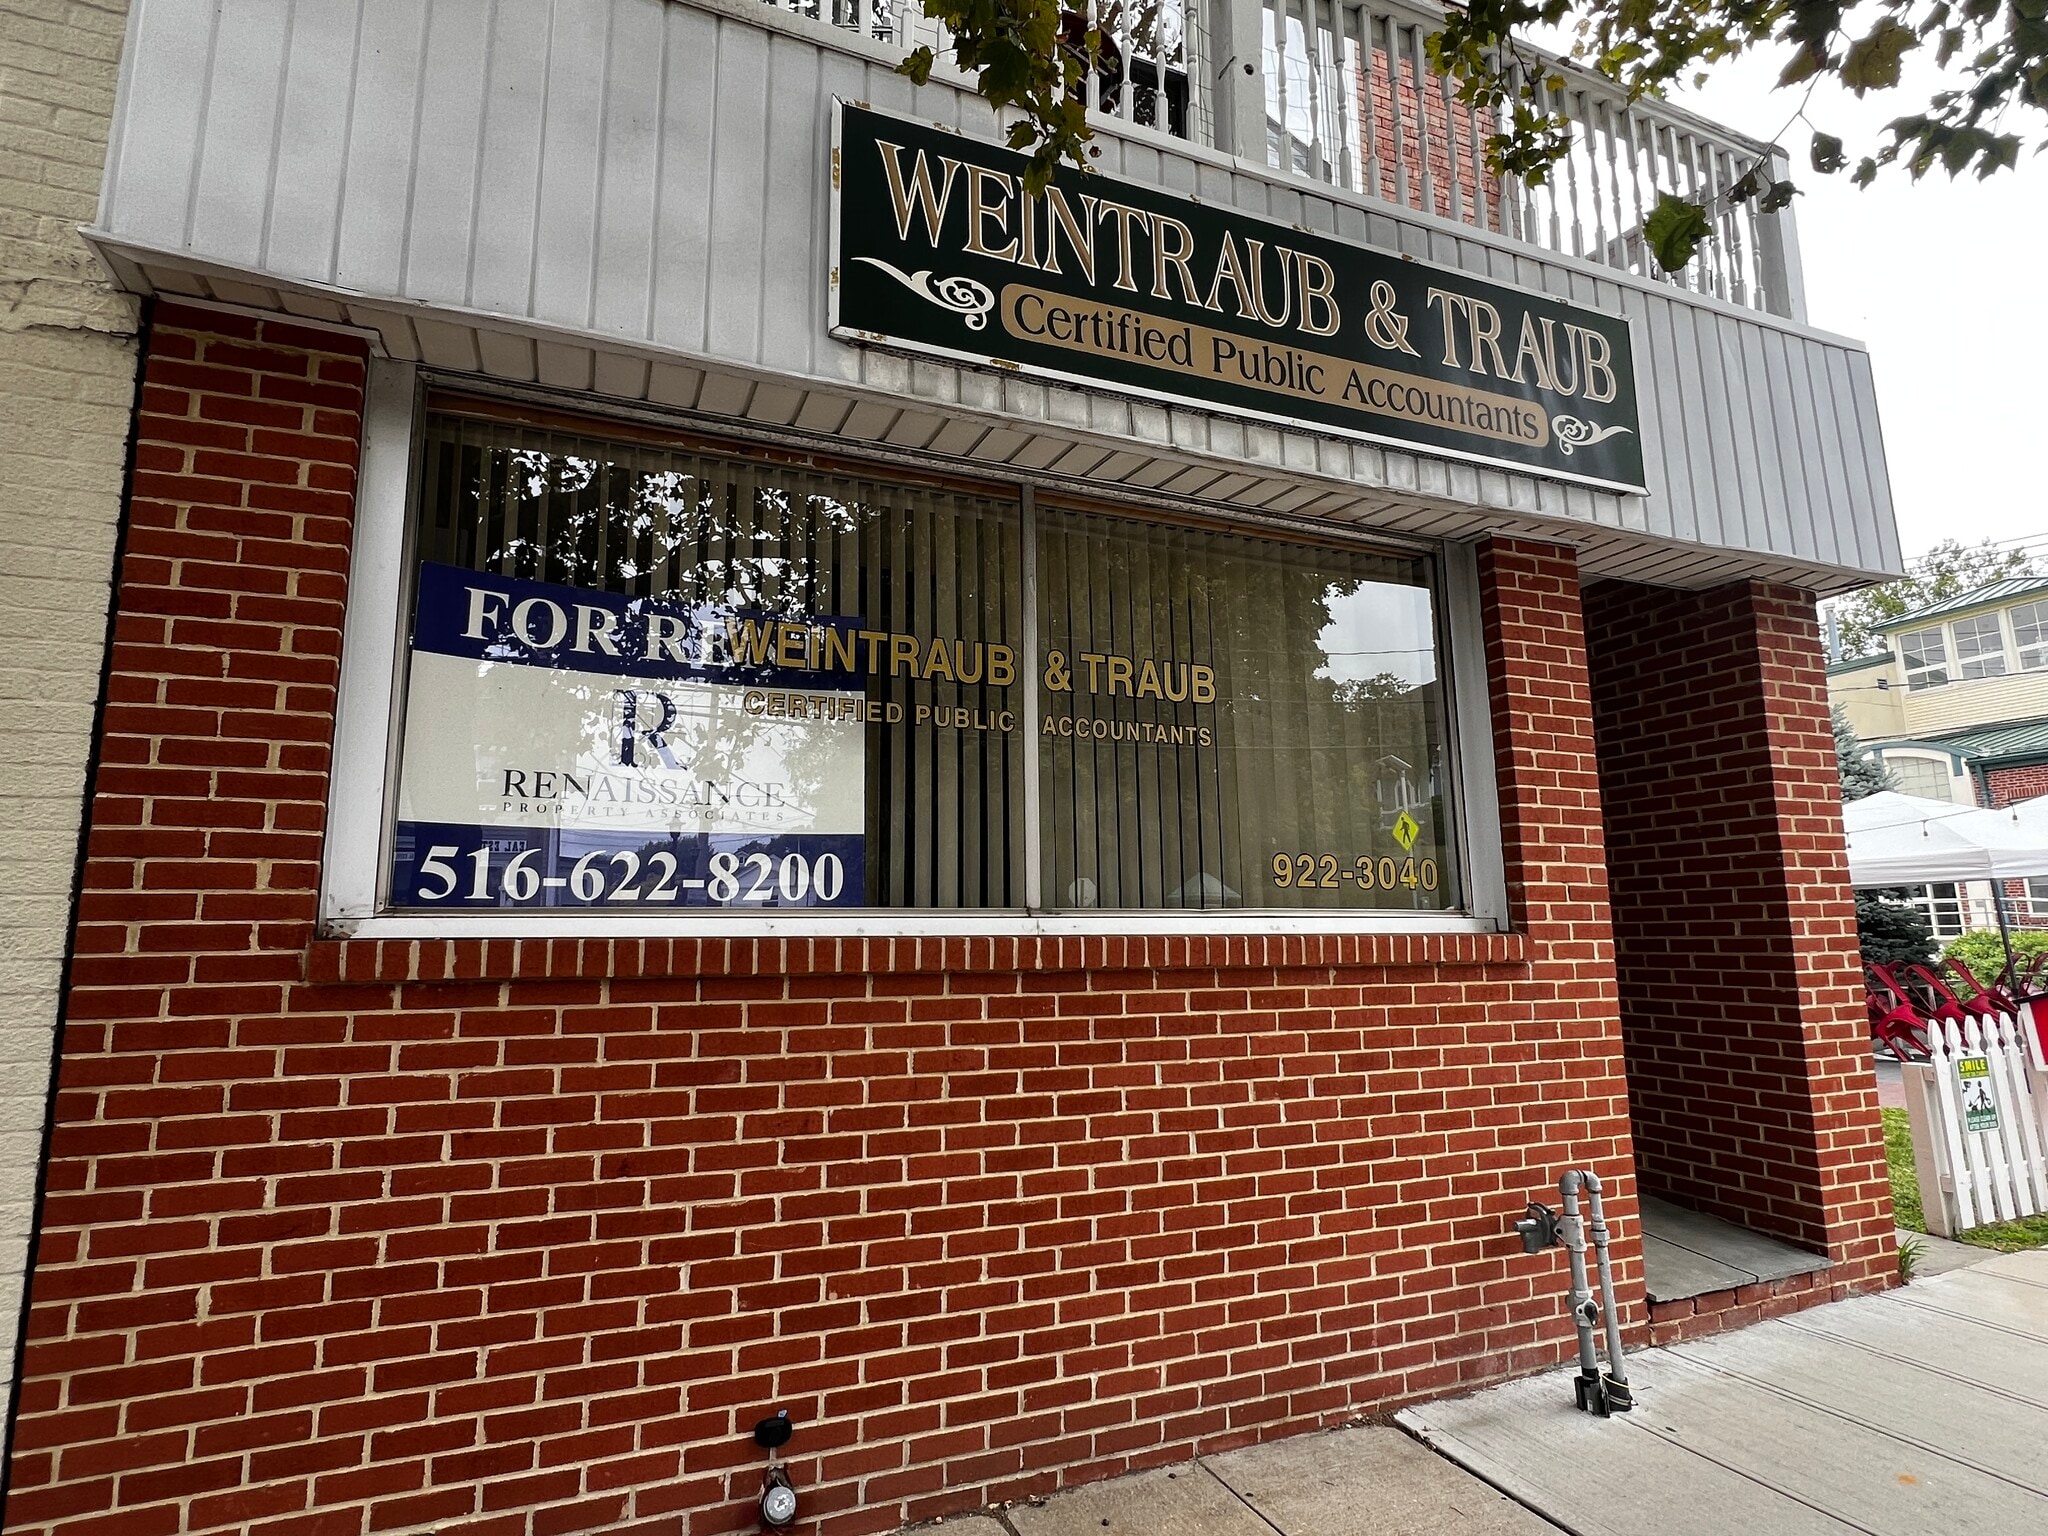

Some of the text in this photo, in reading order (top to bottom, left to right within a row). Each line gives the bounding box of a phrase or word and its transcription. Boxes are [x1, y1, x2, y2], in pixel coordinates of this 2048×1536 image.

[875, 138, 1617, 403] WEINTRAUB & TRAUB
[1014, 293, 1539, 440] Certified Public Accountants
[460, 586, 842, 673] FOR RE
[724, 616, 1217, 705] WEINTRAUB & TRAUB
[743, 690, 1212, 747] CERTIFIED PUBLIC ACCOUNTANTS
[501, 768, 786, 809] RENAISSANCE
[503, 802, 784, 821] PROPERTY ASSOCIATES
[418, 845, 844, 902] 516-622-8200
[1271, 851, 1439, 891] 922-3040
[1960, 1059, 1986, 1072] SMILE
